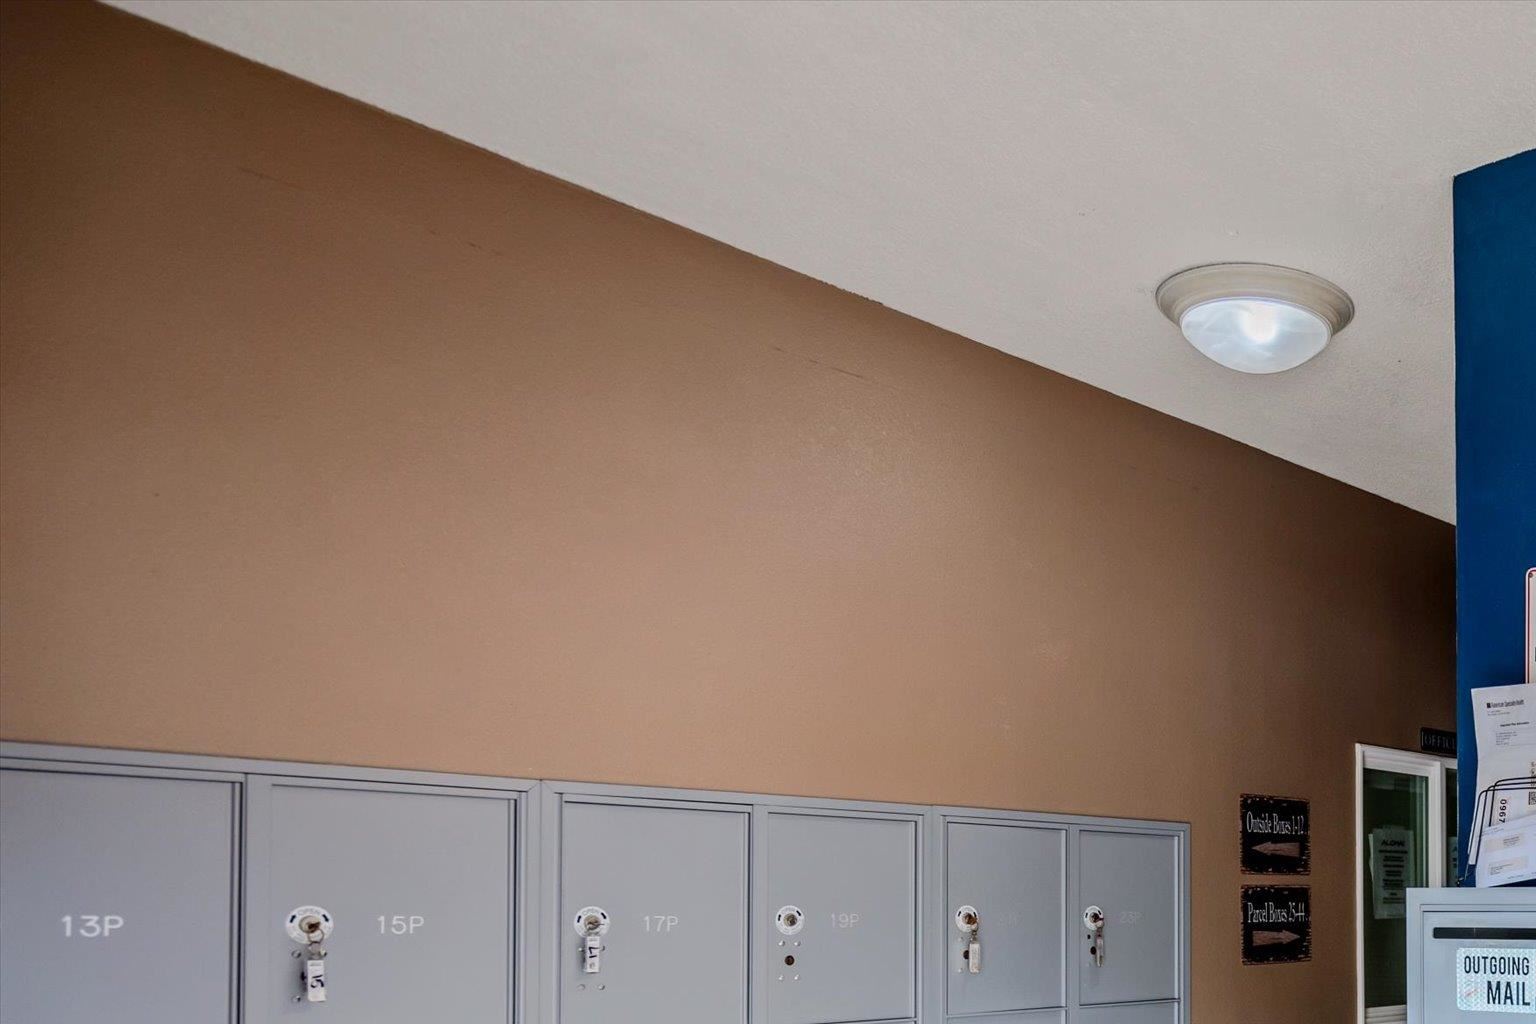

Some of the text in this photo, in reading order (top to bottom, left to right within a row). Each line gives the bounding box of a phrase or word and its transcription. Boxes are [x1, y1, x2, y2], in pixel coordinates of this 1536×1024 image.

[1498, 799, 1507, 823] 0967
[1246, 811, 1272, 834] Outside
[1273, 813, 1291, 835] Boxes
[831, 913, 860, 929] 19P
[1247, 902, 1268, 923] Parcel
[1269, 902, 1288, 923] Boxes
[61, 915, 124, 937] 13P
[377, 915, 425, 935] 15P
[644, 915, 679, 932] 17P
[588, 946, 600, 959] 17
[1464, 955, 1530, 976] OUTGOING
[1487, 980, 1531, 1006] MAIL
